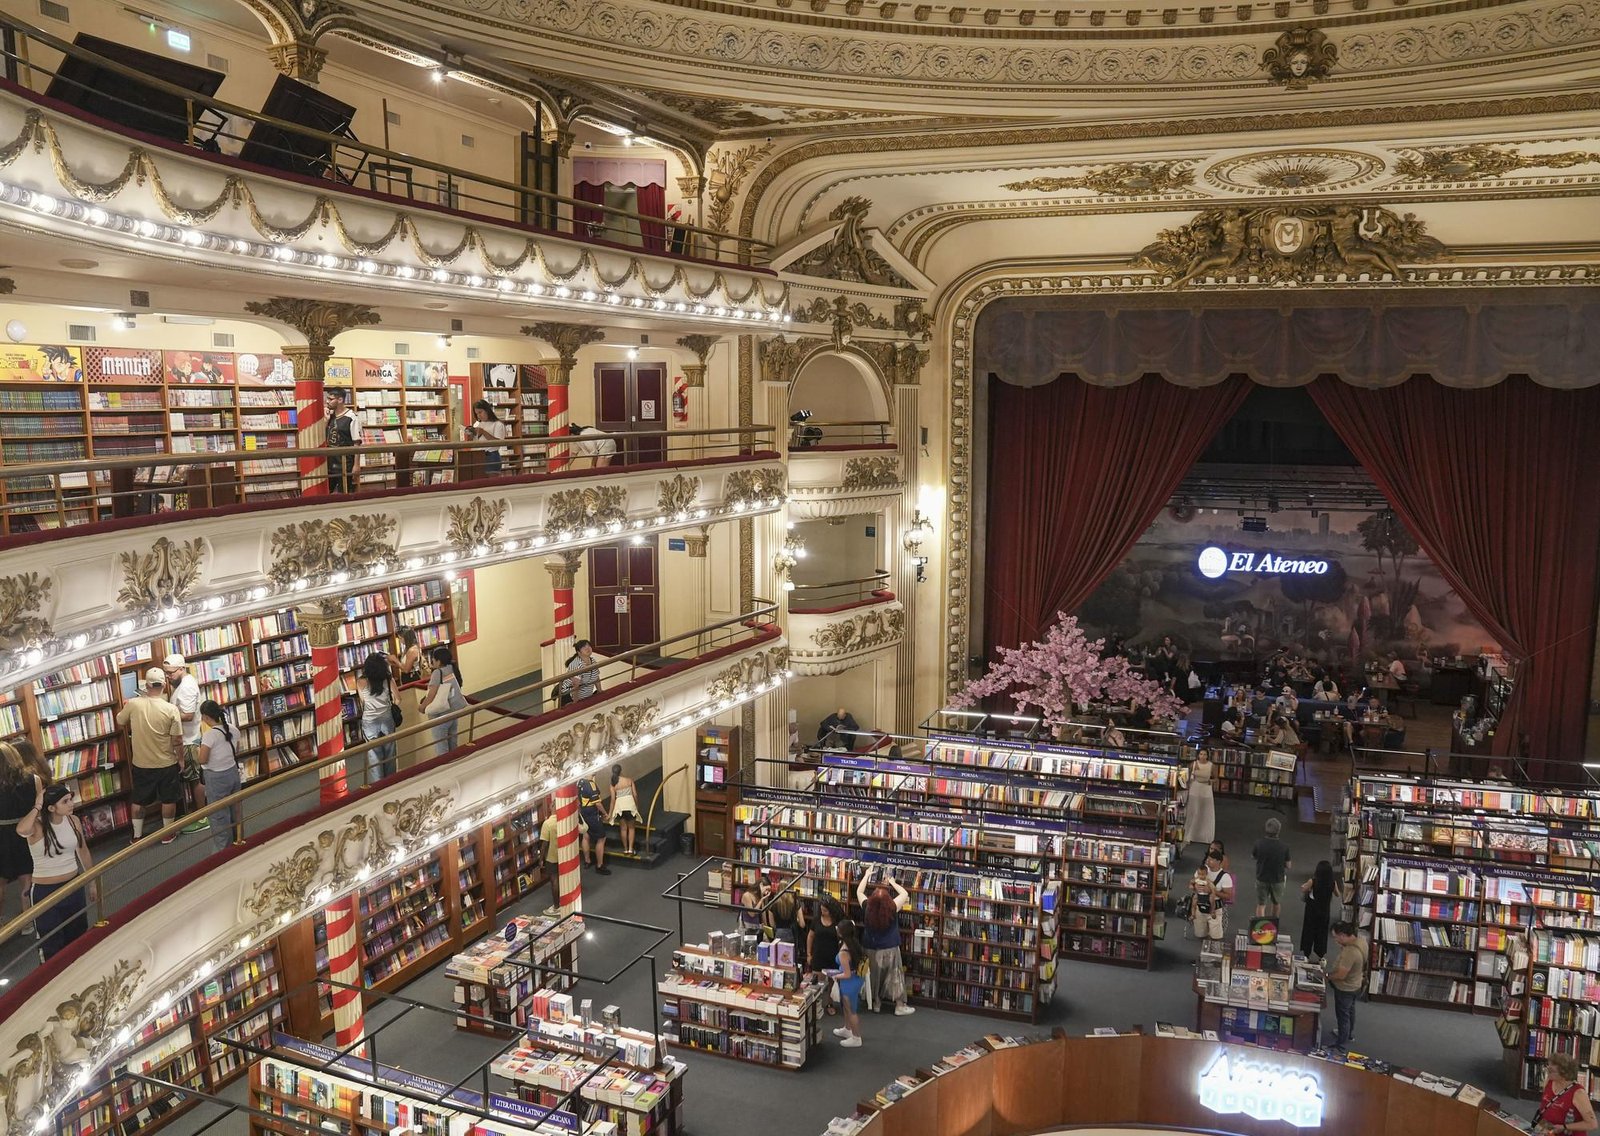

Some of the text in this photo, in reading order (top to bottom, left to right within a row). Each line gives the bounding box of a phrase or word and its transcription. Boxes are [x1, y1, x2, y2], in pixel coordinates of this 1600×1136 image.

[101, 356, 151, 376] MANGA
[365, 369, 392, 378] MANGA
[1228, 552, 1328, 575] El Ateneo
[776, 794, 802, 802] LITERARIA
[835, 800, 855, 808] CRÍTICA
[886, 857, 919, 866] POLICIALES
[978, 870, 1012, 878] POLICIALES
[1493, 868, 1530, 878] MARKETING
[1536, 873, 1575, 882] PUBLICIDAD
[306, 1042, 338, 1057] LITERATURA
[412, 1075, 446, 1090] LITERATURA
[495, 1098, 572, 1125] LITERATURA LATINOAERICANA
